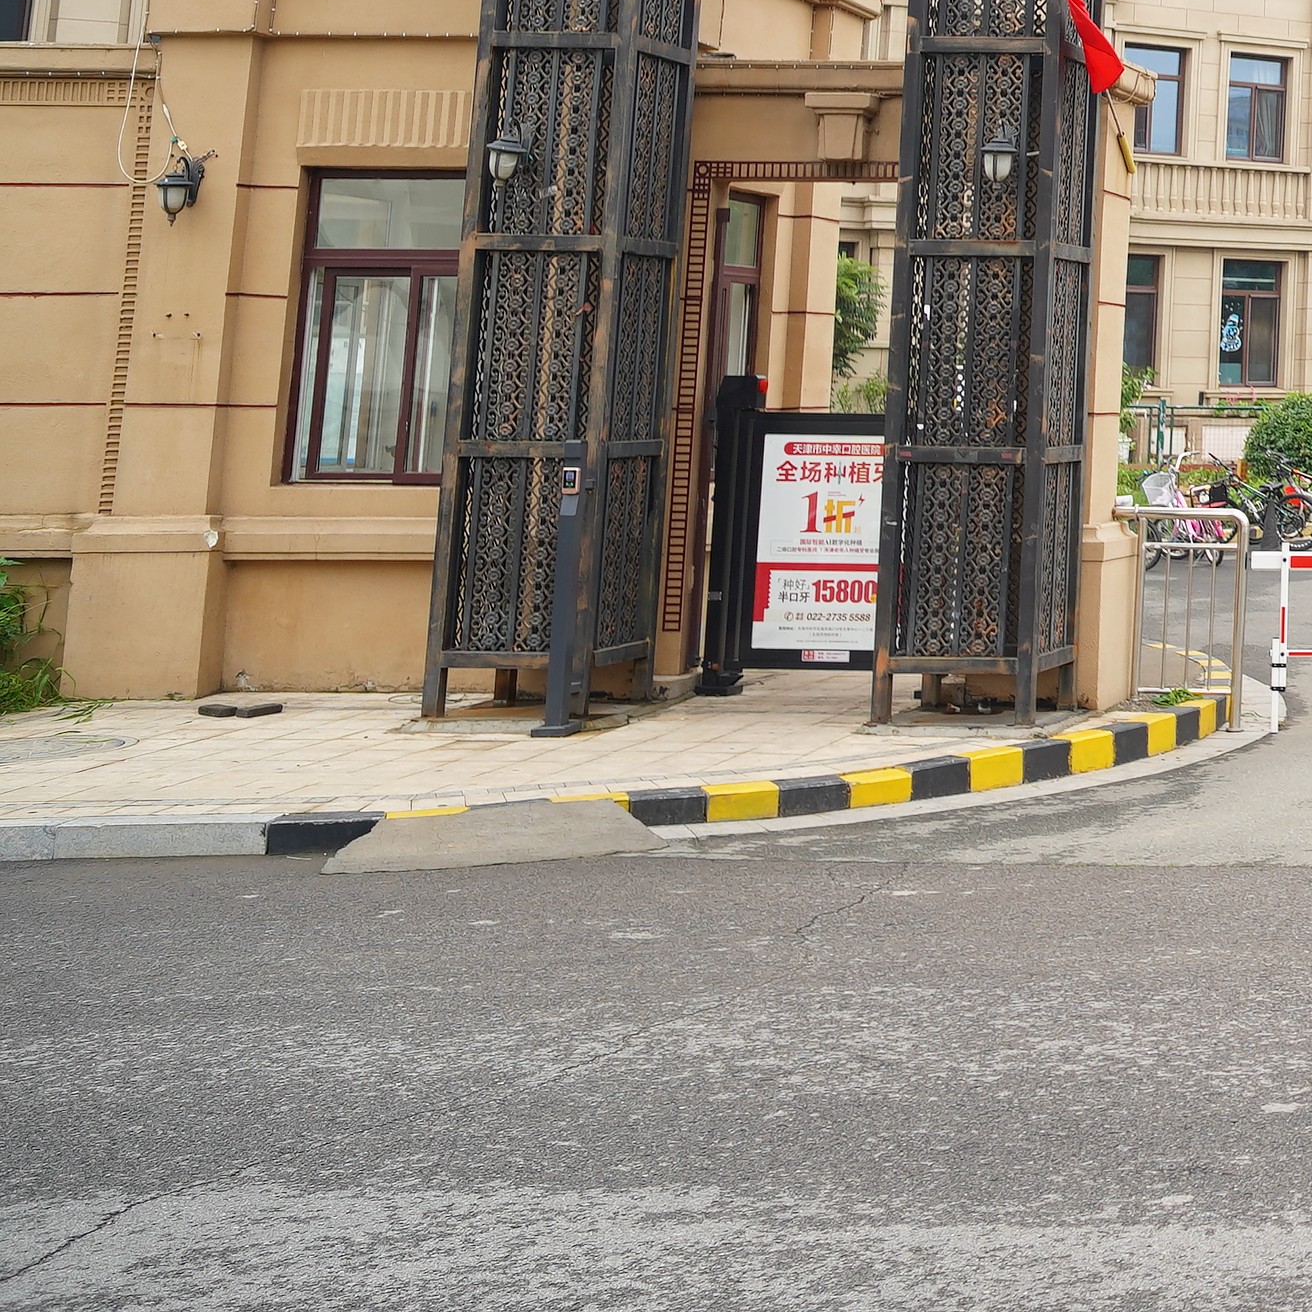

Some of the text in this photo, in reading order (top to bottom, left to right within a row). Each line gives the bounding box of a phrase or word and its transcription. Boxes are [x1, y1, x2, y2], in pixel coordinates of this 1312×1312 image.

[812, 580, 877, 603] 15800
[778, 592, 810, 603] 半口牙
[806, 613, 847, 621] 022-2735
[849, 614, 871, 622] 5588
